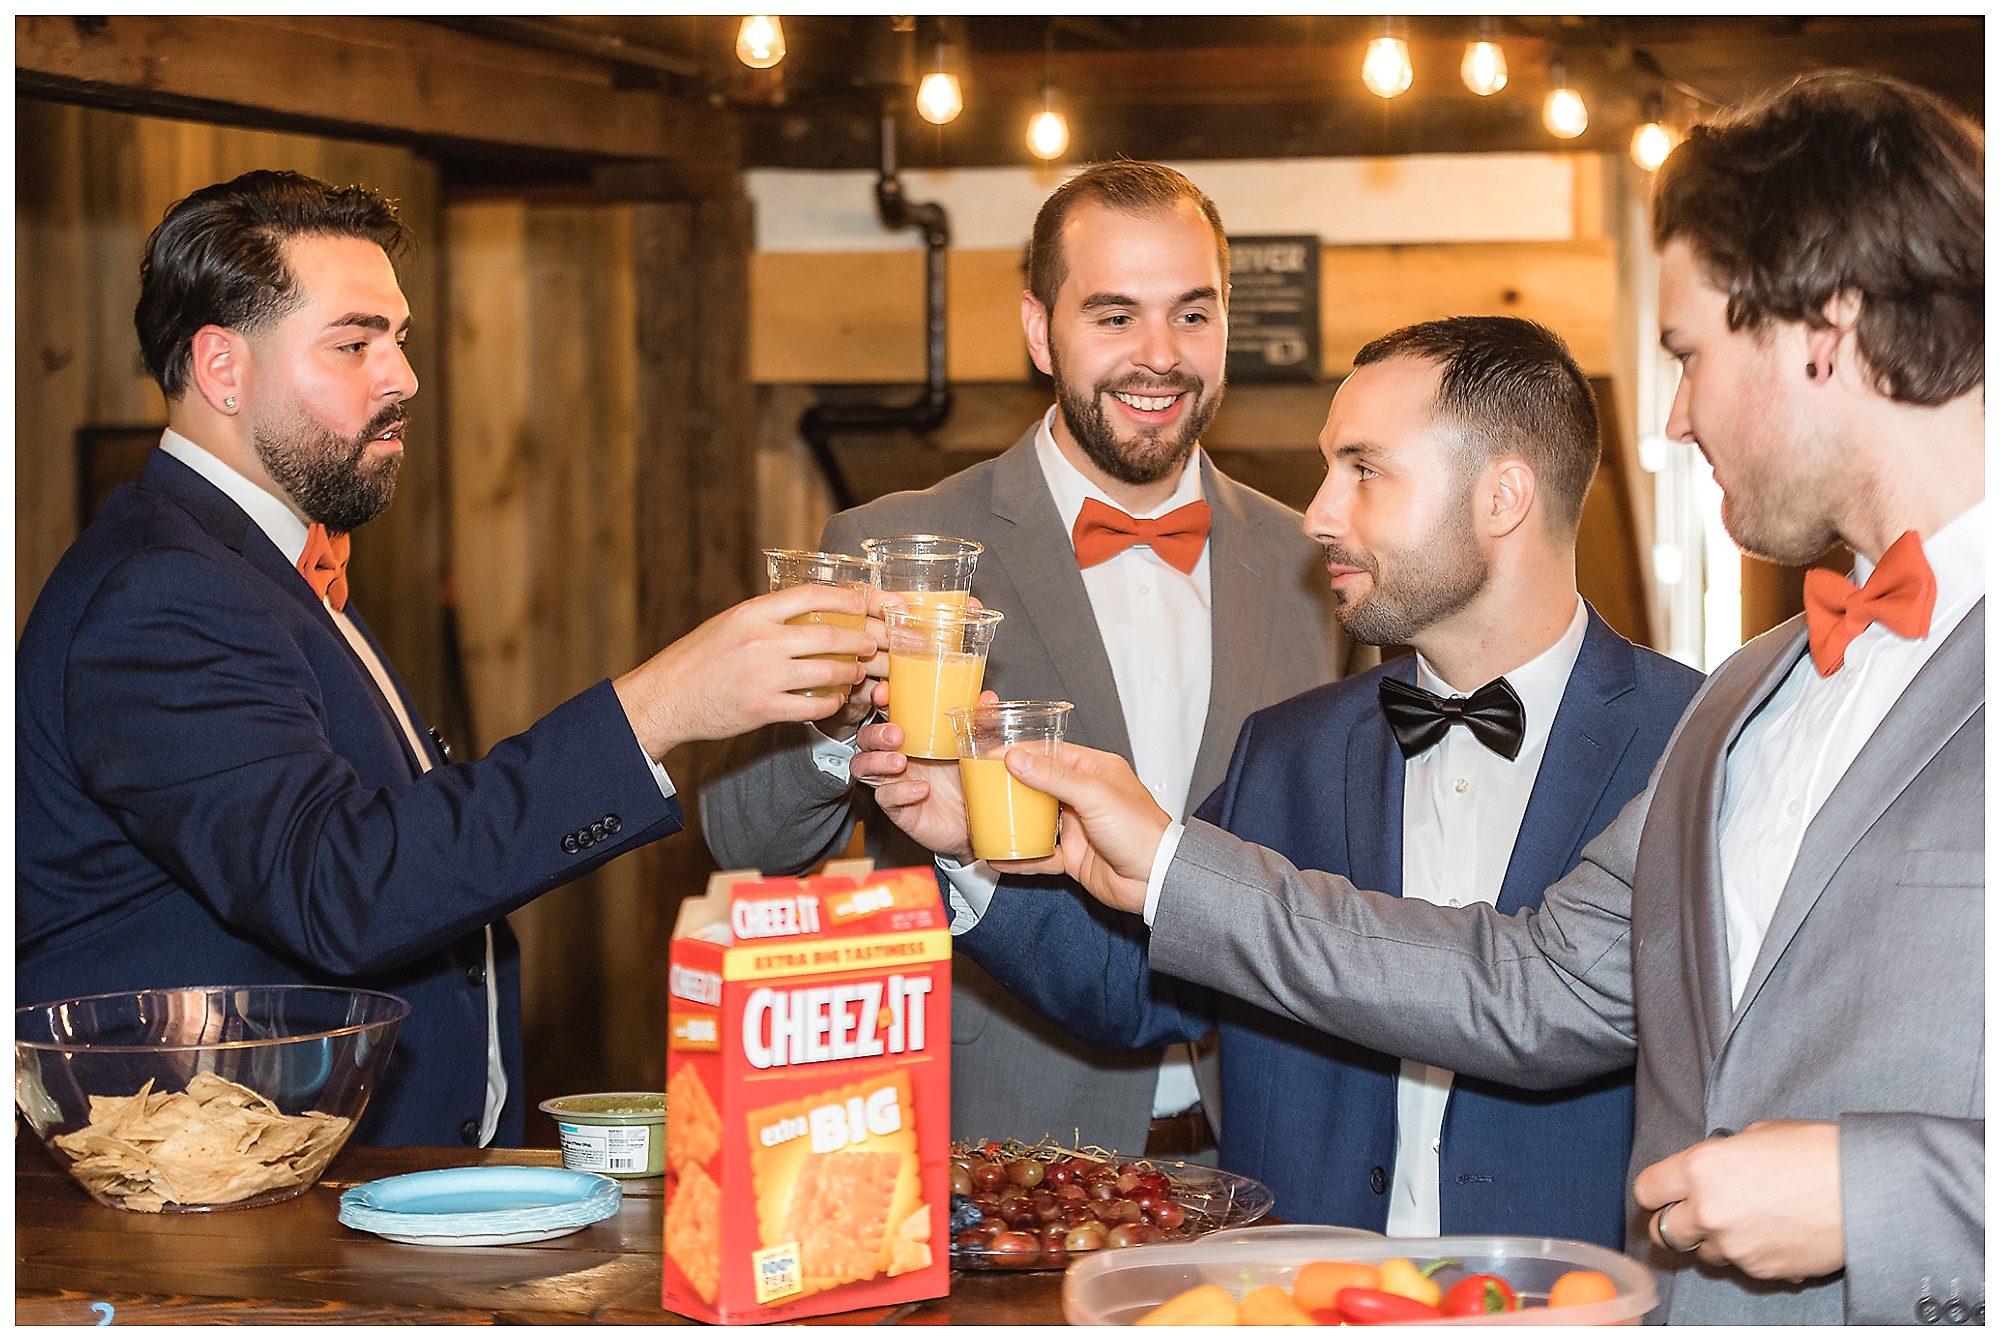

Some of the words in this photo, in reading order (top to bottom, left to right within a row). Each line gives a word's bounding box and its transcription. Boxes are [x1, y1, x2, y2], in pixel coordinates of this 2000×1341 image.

[755, 952, 807, 971] EXTRA
[813, 949, 840, 965] BIG
[844, 941, 926, 961] TASTINESS
[760, 1115, 809, 1148] extra
[809, 1086, 901, 1154] BIG
